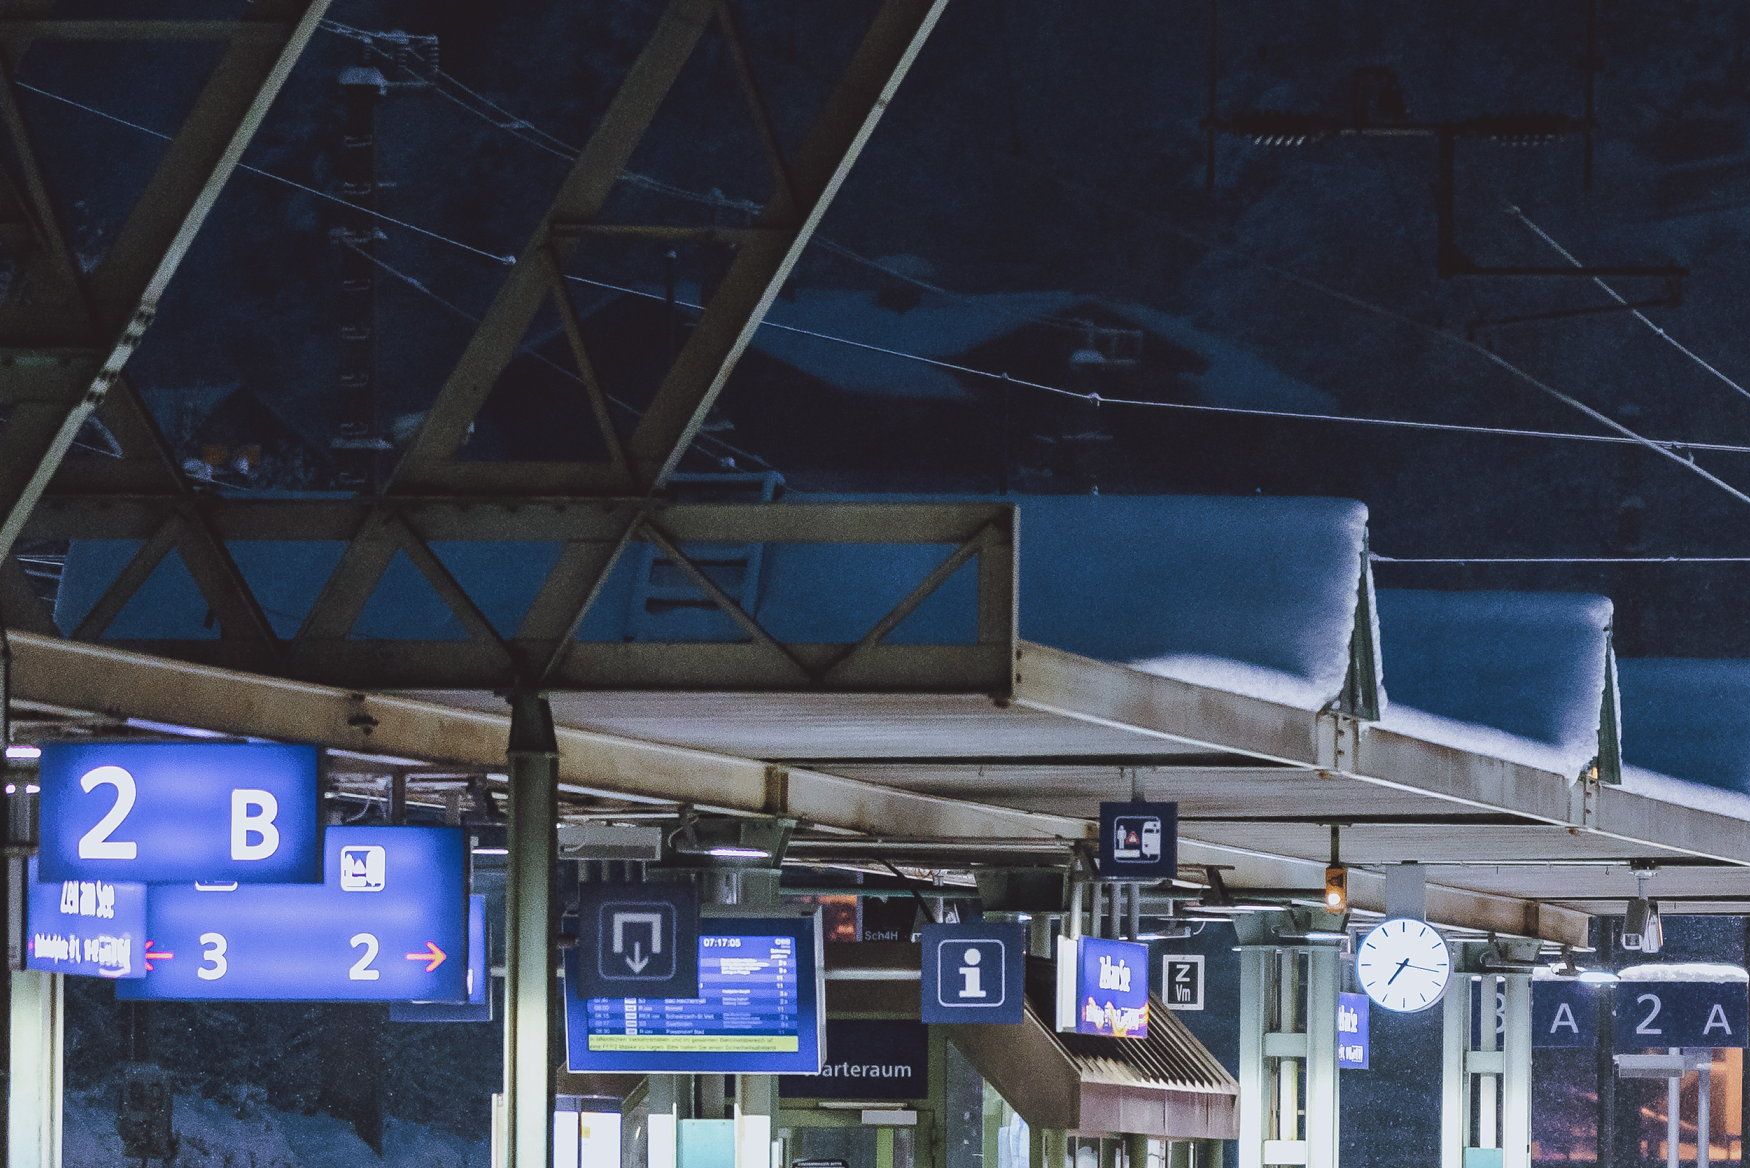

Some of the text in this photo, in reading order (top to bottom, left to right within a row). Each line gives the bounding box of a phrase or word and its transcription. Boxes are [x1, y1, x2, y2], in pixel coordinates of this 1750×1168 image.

[78, 766, 280, 861] 2 B
[197, 933, 381, 980] 3 2
[1175, 964, 1190, 982] Z
[1175, 984, 1191, 1002] Vm
[1549, 1002, 1579, 1034] A
[1636, 993, 1732, 1035] 2 A
[806, 1062, 912, 1078] arteraum
